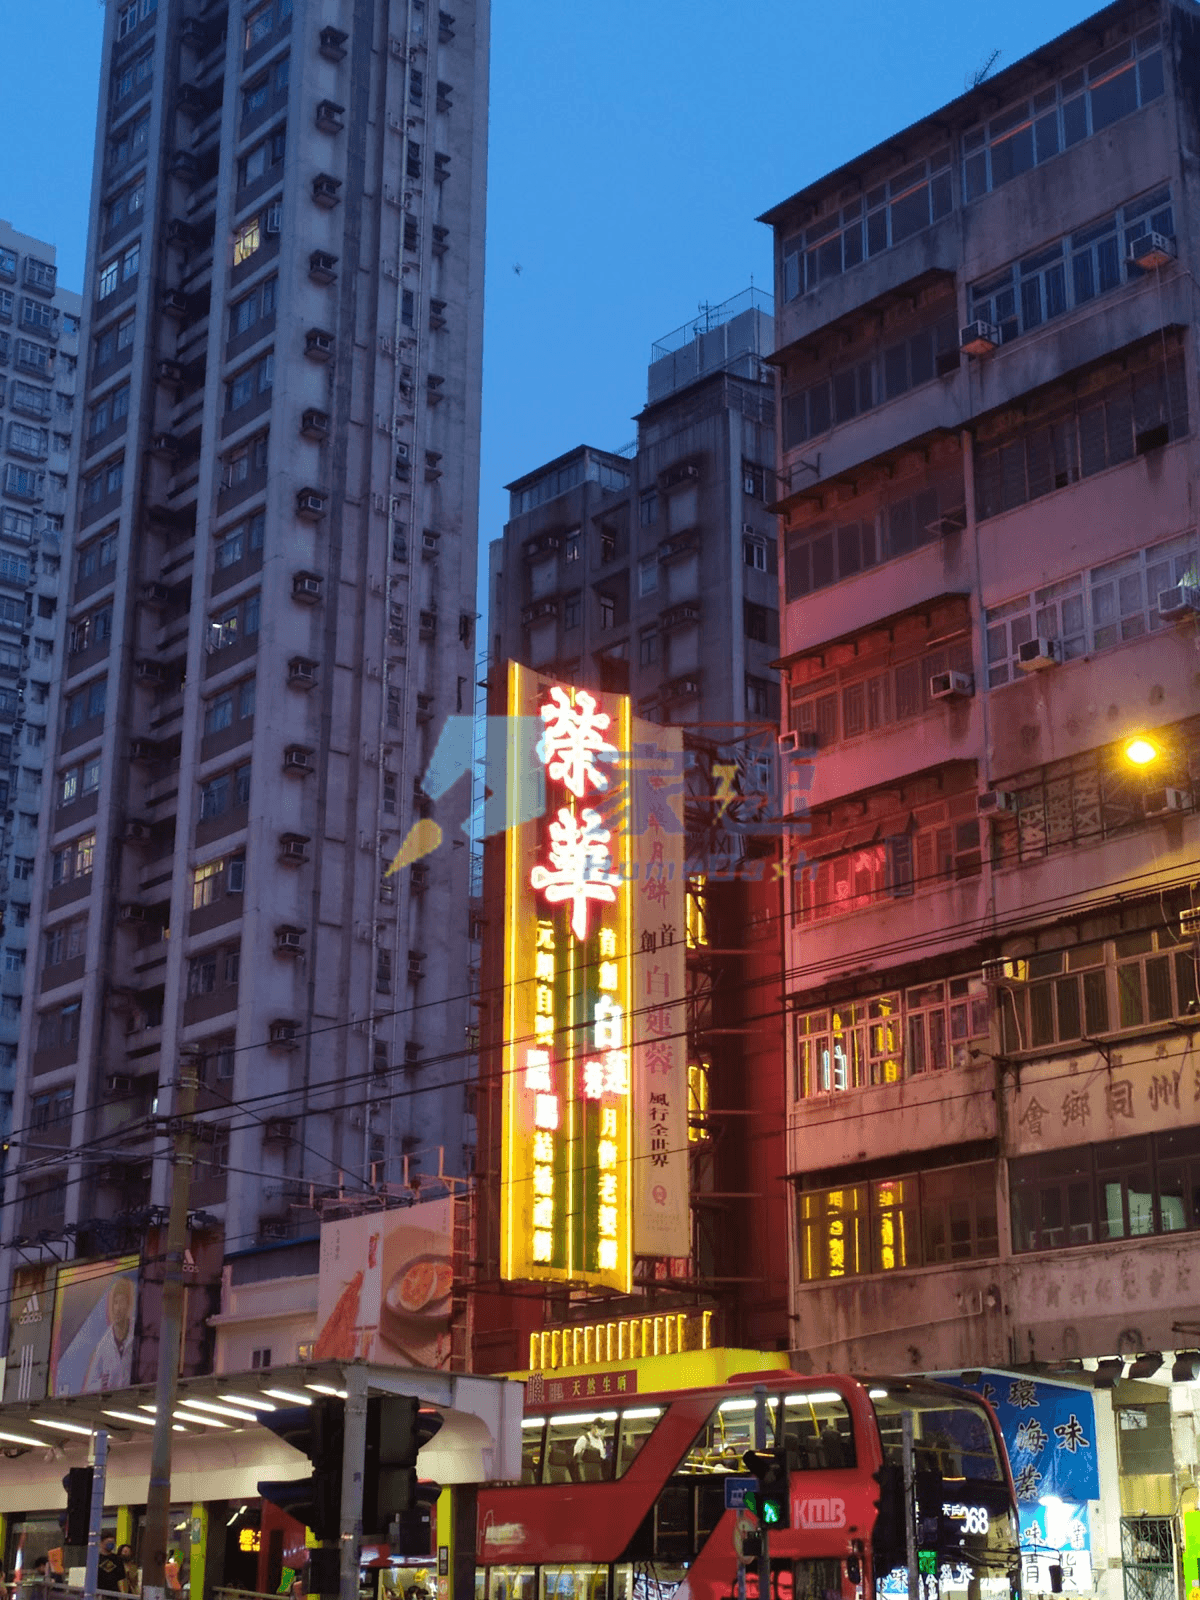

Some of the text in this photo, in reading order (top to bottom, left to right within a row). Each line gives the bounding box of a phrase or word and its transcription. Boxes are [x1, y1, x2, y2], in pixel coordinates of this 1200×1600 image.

[531, 686, 622, 941] 榮華
[649, 1092, 670, 1168] 風行全世界
[19, 1311, 42, 1325] adidas
[1016, 1414, 1090, 1454] 海味
[794, 1498, 846, 1529] KMB
